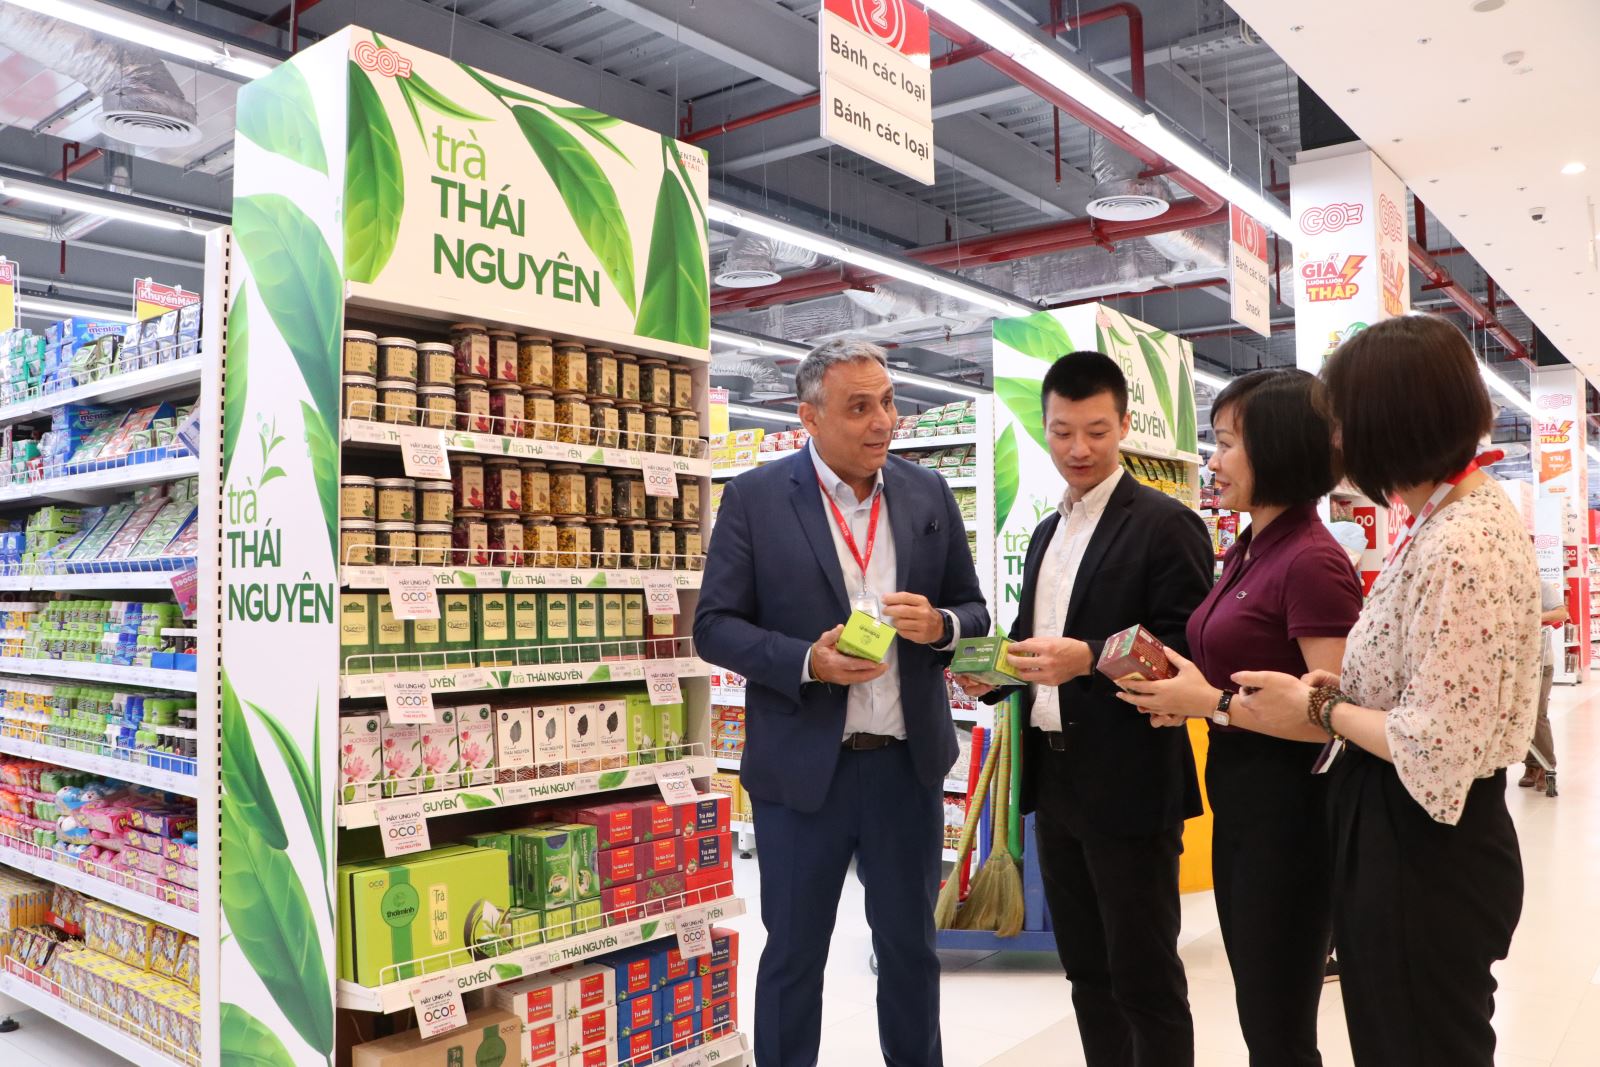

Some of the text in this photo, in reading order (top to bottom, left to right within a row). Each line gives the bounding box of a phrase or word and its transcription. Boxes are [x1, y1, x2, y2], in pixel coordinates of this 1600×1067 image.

[871, 0, 888, 29] 2
[830, 34, 926, 102] Bánh các loại
[834, 97, 929, 160] Bánh các loại
[432, 125, 486, 181] trà
[431, 175, 525, 237] THÁI
[433, 232, 600, 307] NGUYÊN
[1128, 380, 1145, 401] HÁI
[1131, 409, 1166, 440] GUYÊN
[227, 476, 257, 525] trà
[227, 518, 281, 568] THÁI
[1004, 555, 1025, 575] TH
[228, 571, 334, 624] NGUYÊN
[401, 591, 432, 602] OCOP
[429, 676, 456, 689] UYÊN
[527, 671, 546, 682] THÁI
[548, 668, 583, 681] NGUYÊN
[423, 797, 458, 813] GUYÊN
[528, 782, 549, 797] THÁI
[550, 782, 576, 795] NGUY
[388, 823, 422, 839] OCOP
[432, 889, 446, 905] Trà
[457, 970, 492, 989] GUYÊN
[561, 945, 581, 960] THÁI
[583, 936, 618, 955] NGUYÊN
[424, 1004, 456, 1022] OCOP
